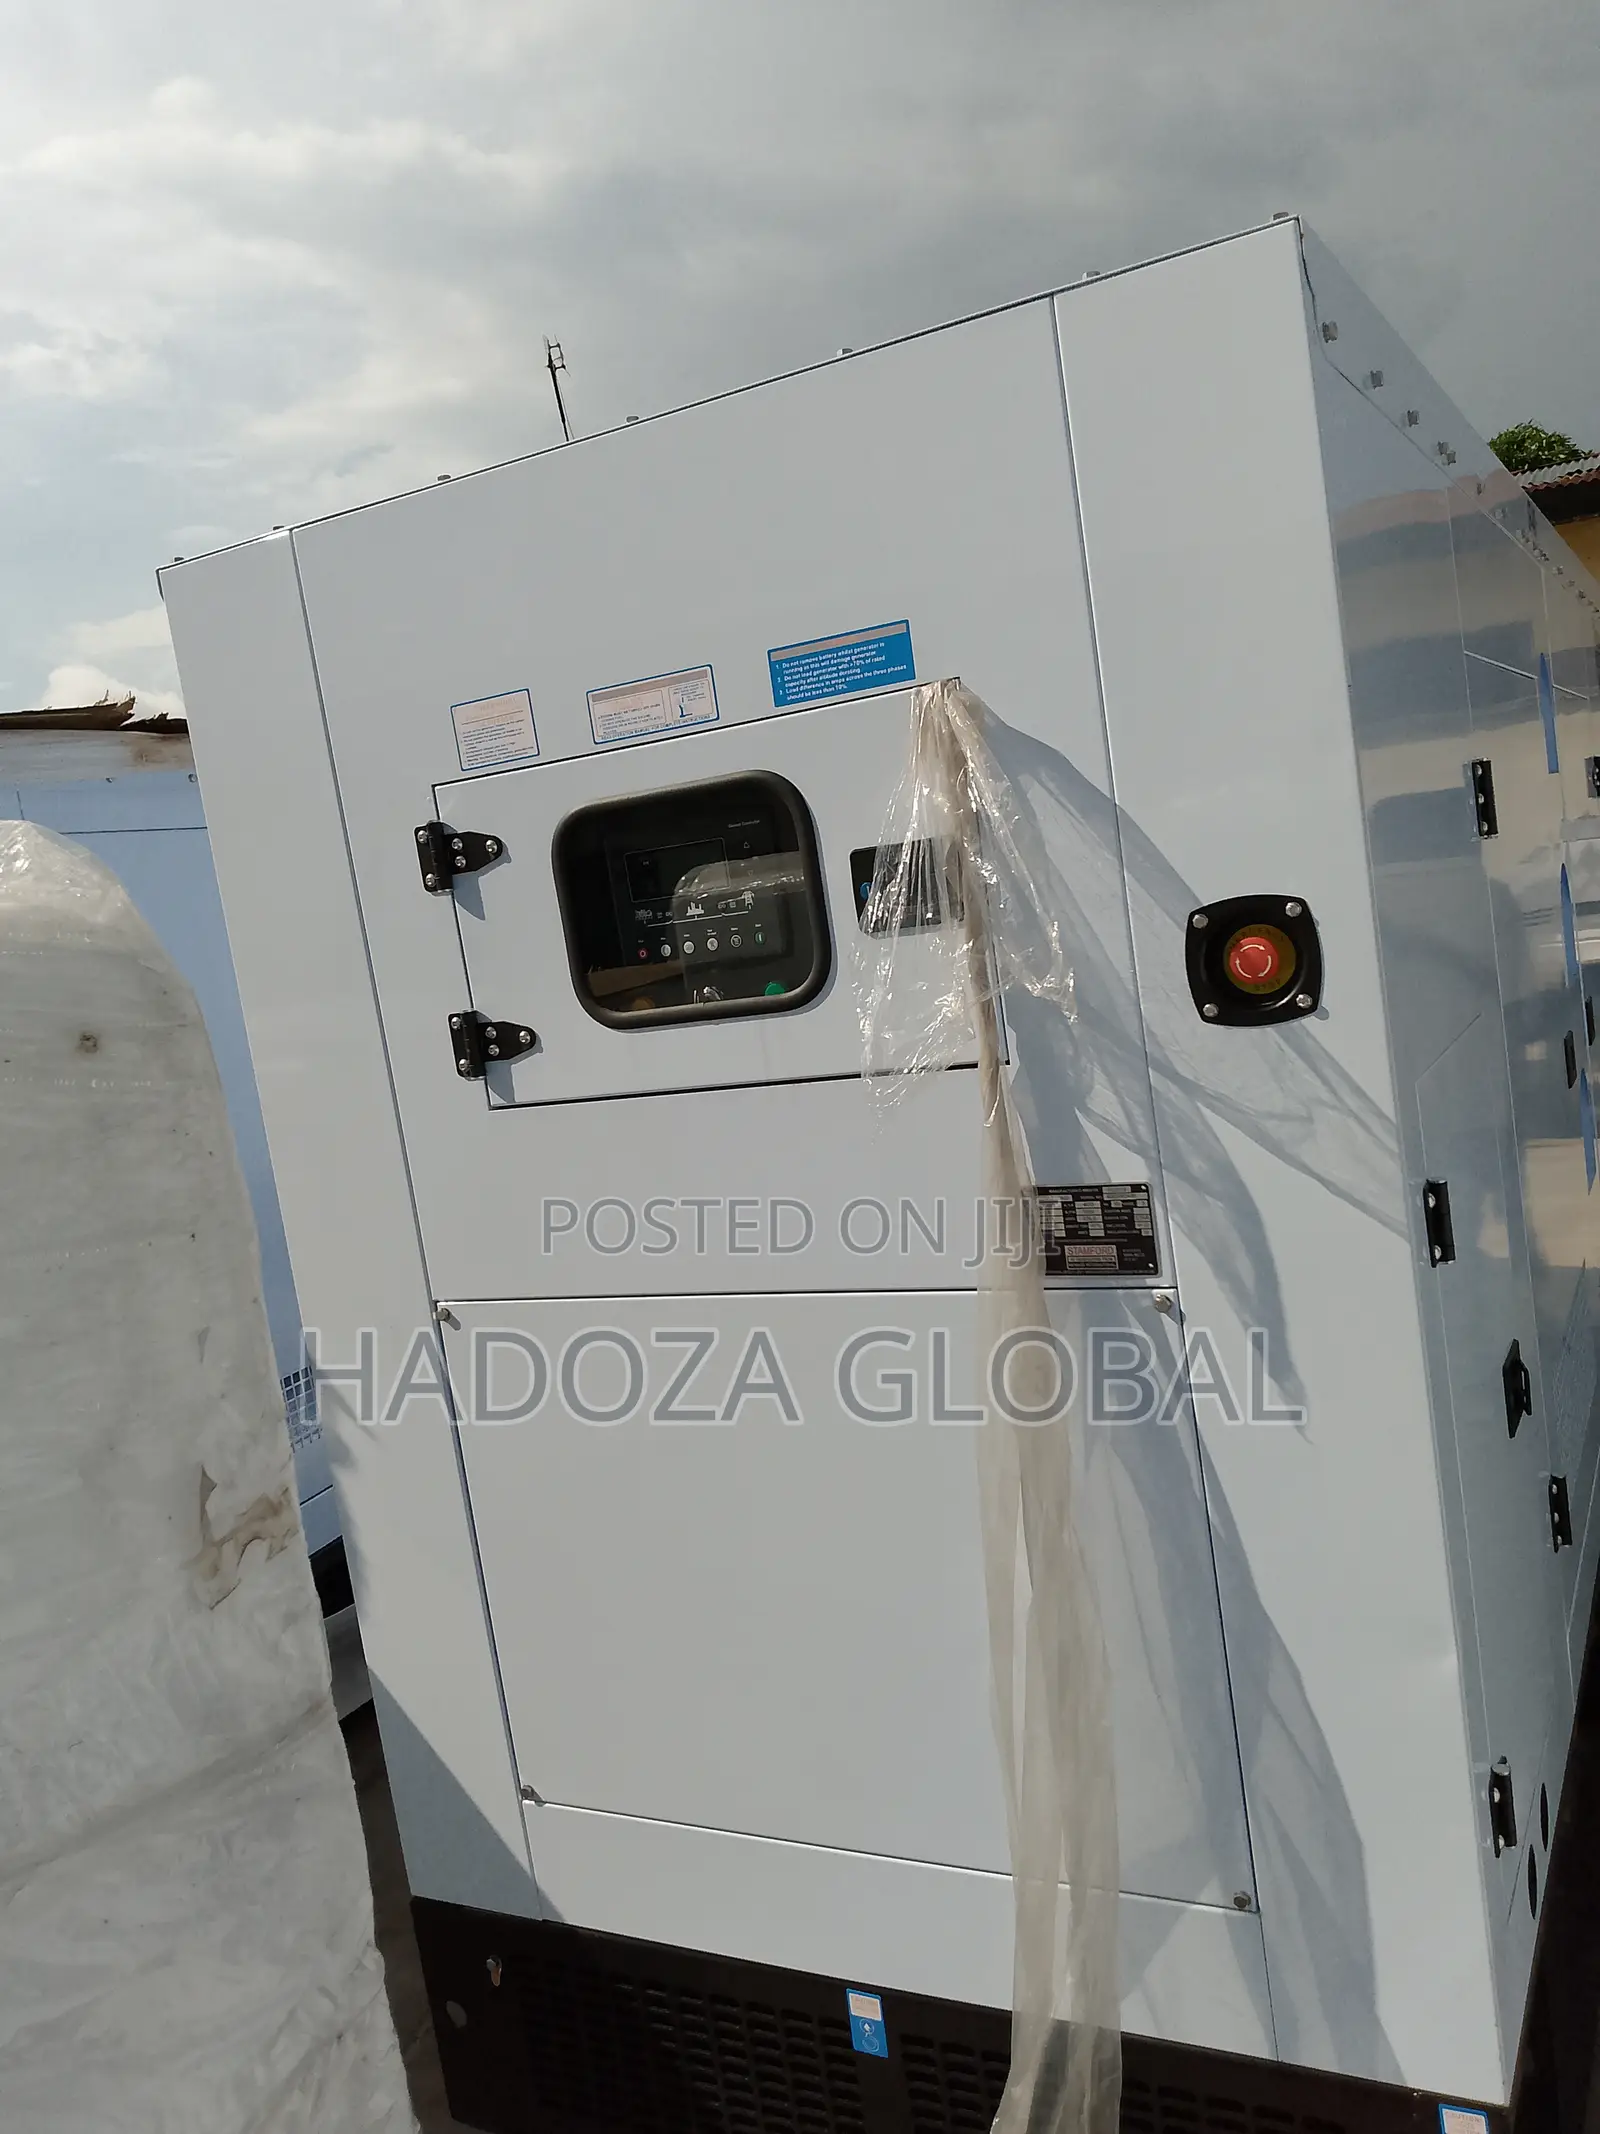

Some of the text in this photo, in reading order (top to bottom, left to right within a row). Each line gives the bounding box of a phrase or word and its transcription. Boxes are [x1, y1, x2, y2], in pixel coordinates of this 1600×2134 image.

[819, 652, 837, 661] battery
[854, 643, 879, 654] generator
[813, 666, 838, 676] generator
[800, 682, 824, 691] difference
[887, 664, 907, 673] phases
[785, 679, 806, 688] capacity
[1067, 1246, 1115, 1255] STAMFORD
